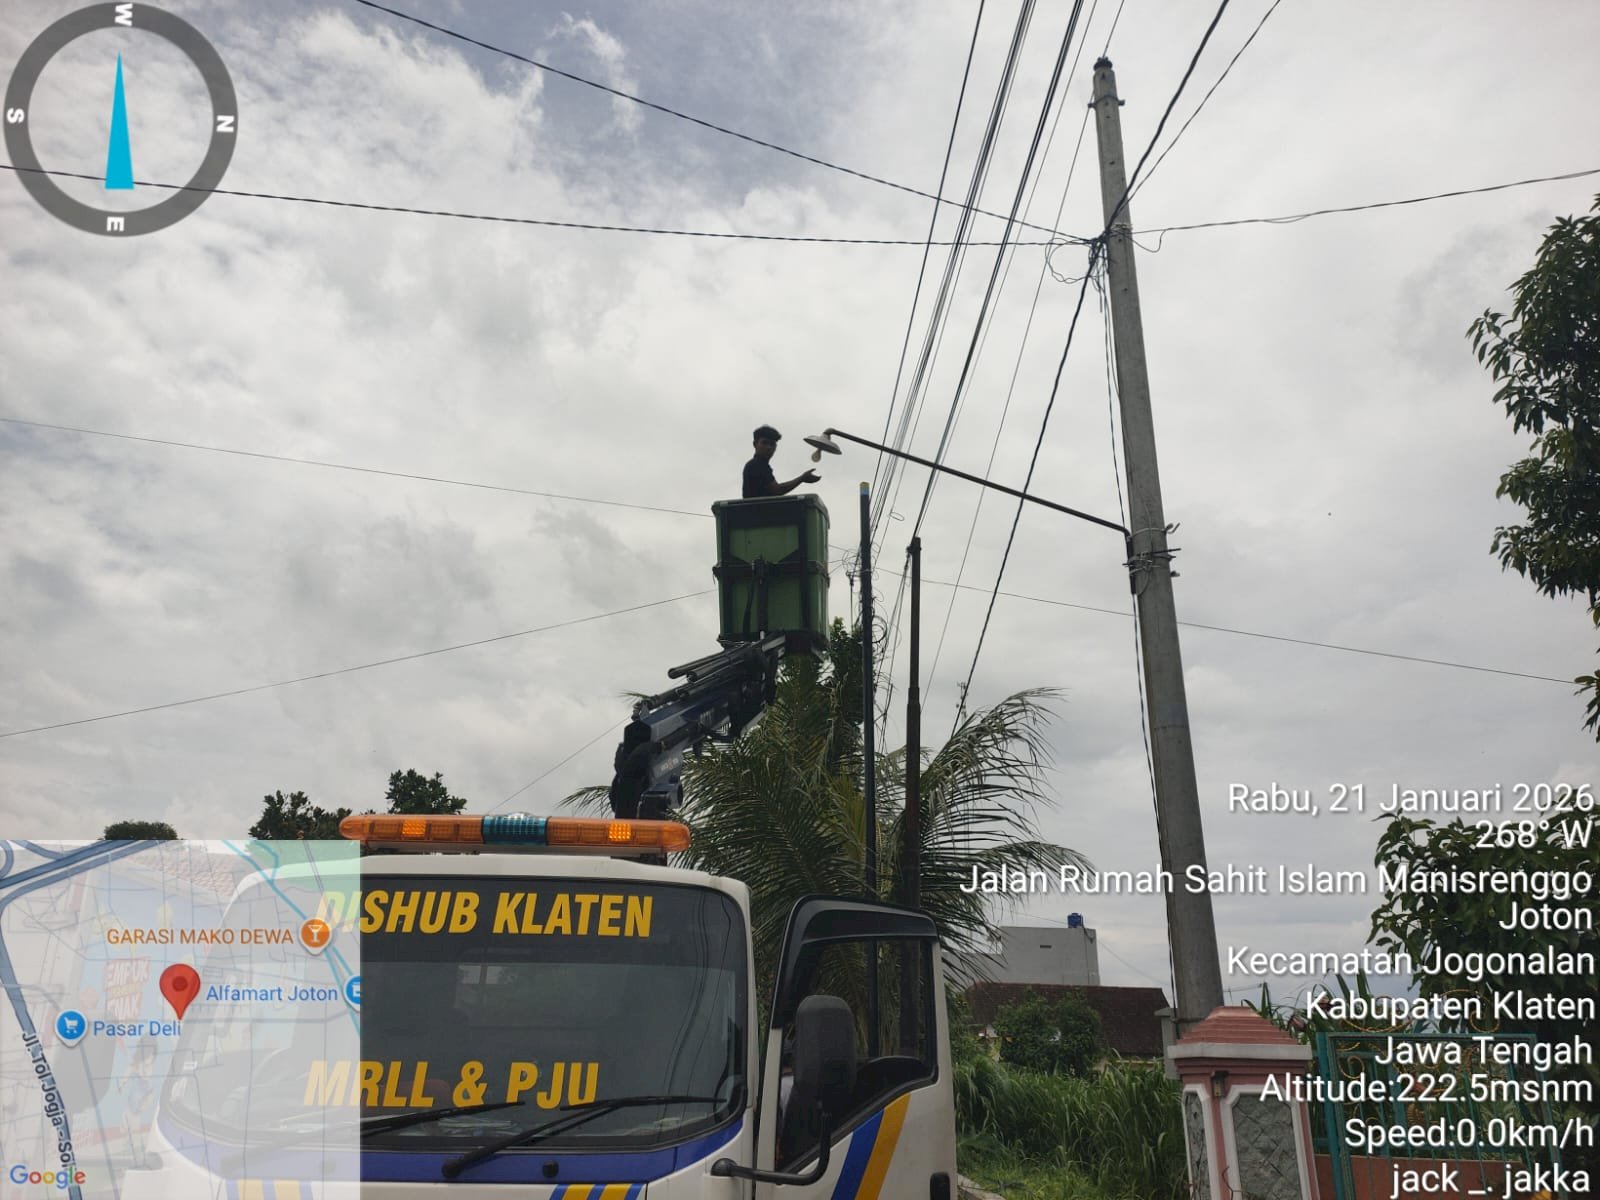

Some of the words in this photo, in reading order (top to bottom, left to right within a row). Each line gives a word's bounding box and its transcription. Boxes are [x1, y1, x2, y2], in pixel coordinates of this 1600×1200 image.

[317, 890, 480, 934] DISHUB
[493, 892, 653, 937] KLATEN
[303, 1060, 433, 1107] MRLL
[452, 1060, 488, 1107] &
[505, 1062, 599, 1109] PJU
